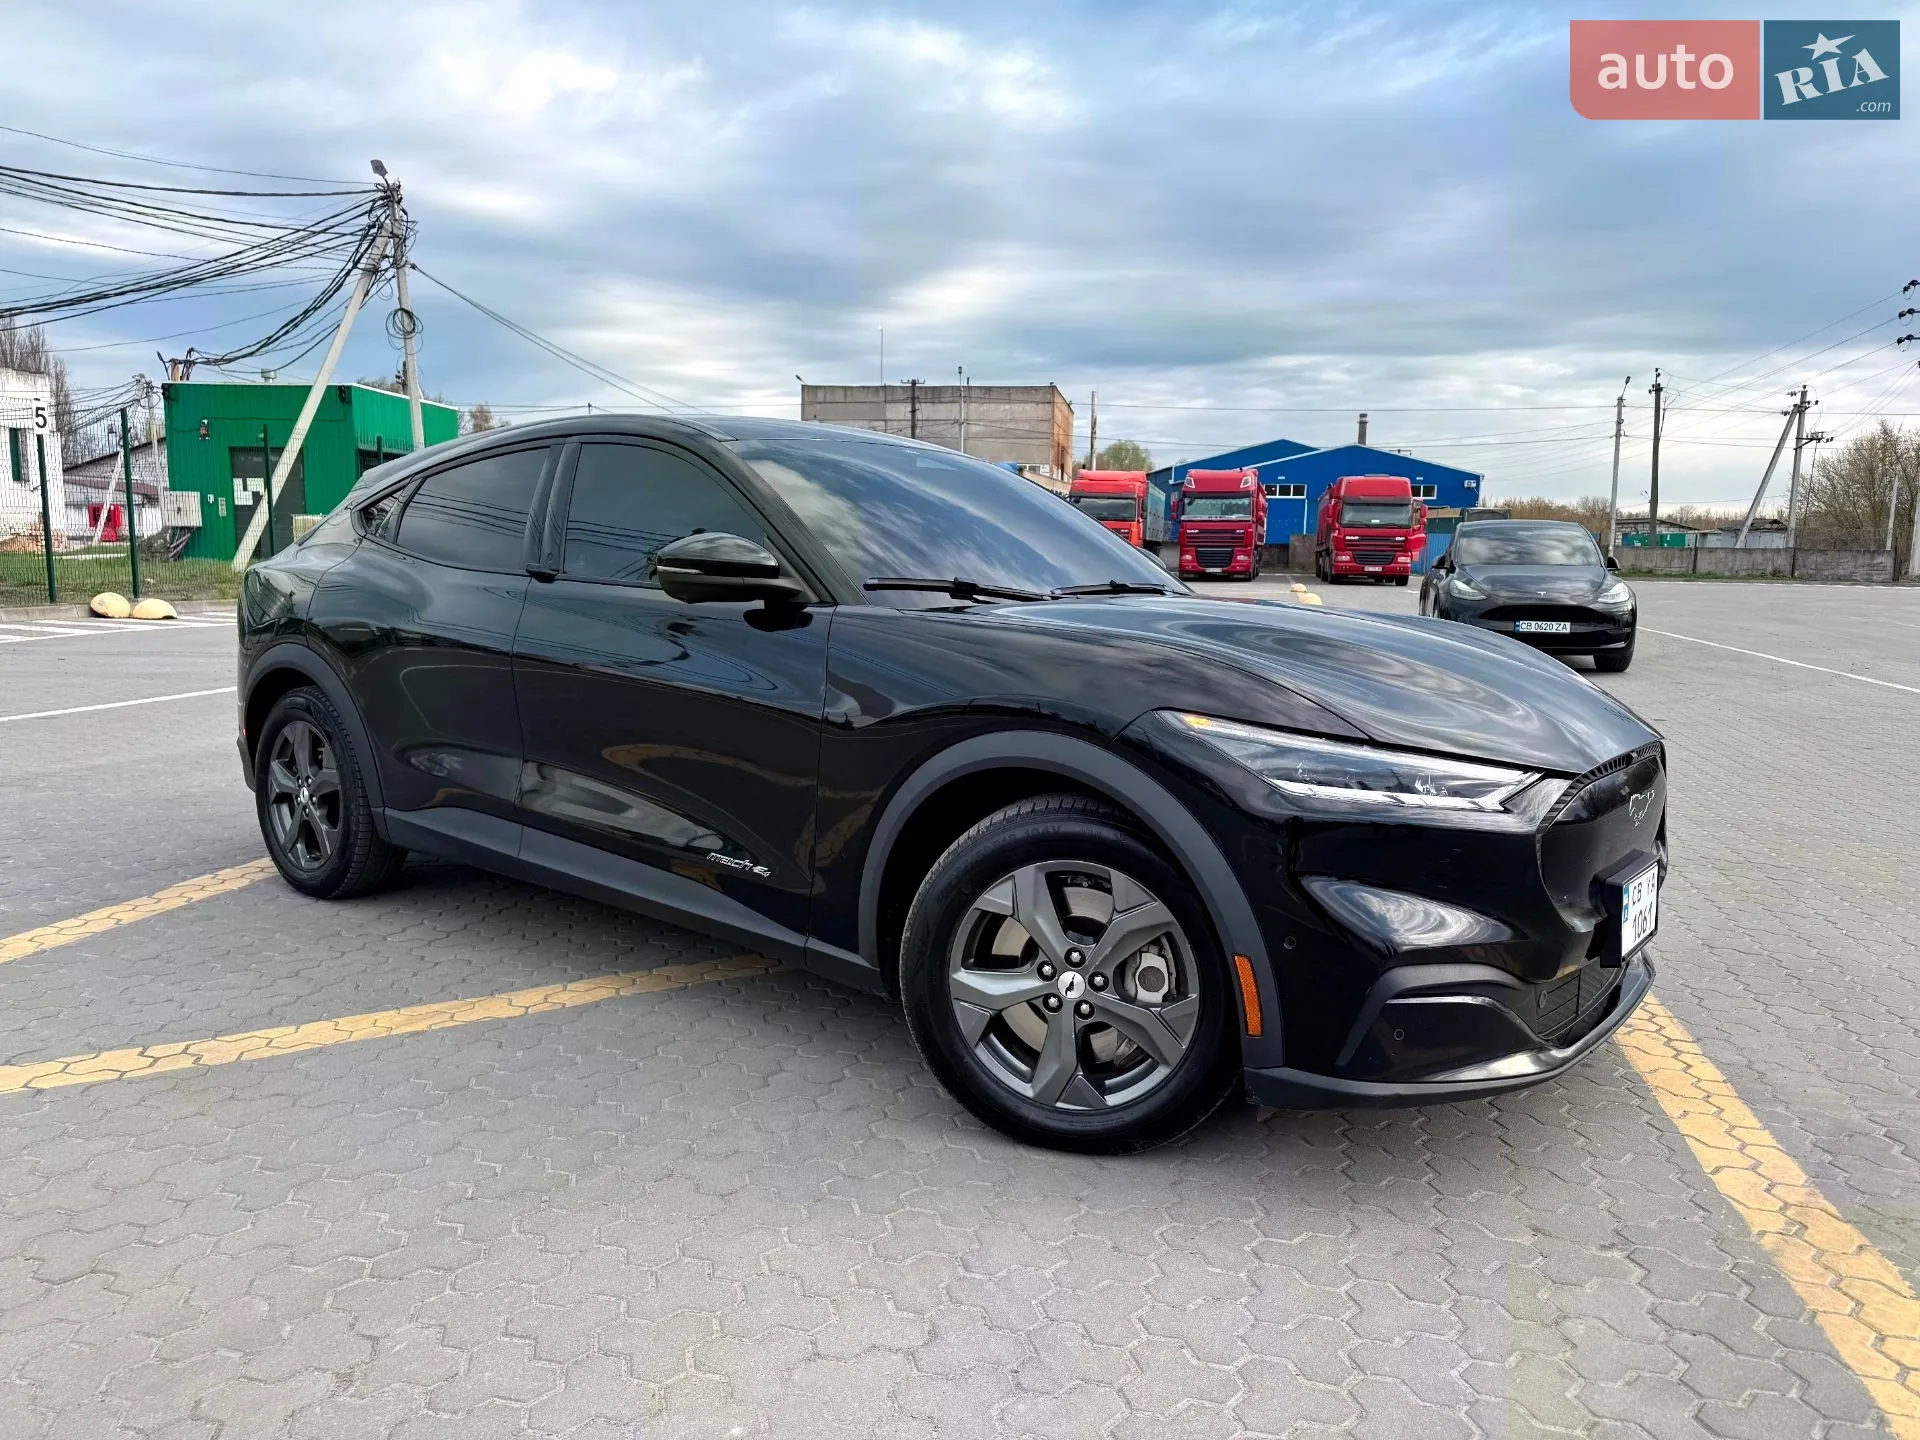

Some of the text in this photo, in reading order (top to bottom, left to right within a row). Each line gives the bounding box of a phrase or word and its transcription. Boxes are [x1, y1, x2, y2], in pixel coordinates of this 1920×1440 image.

[35, 406, 47, 428] 5
[1521, 622, 1568, 632] CB 0620 ZA
[1632, 881, 1642, 906] CB
[1632, 901, 1653, 942] 1061
